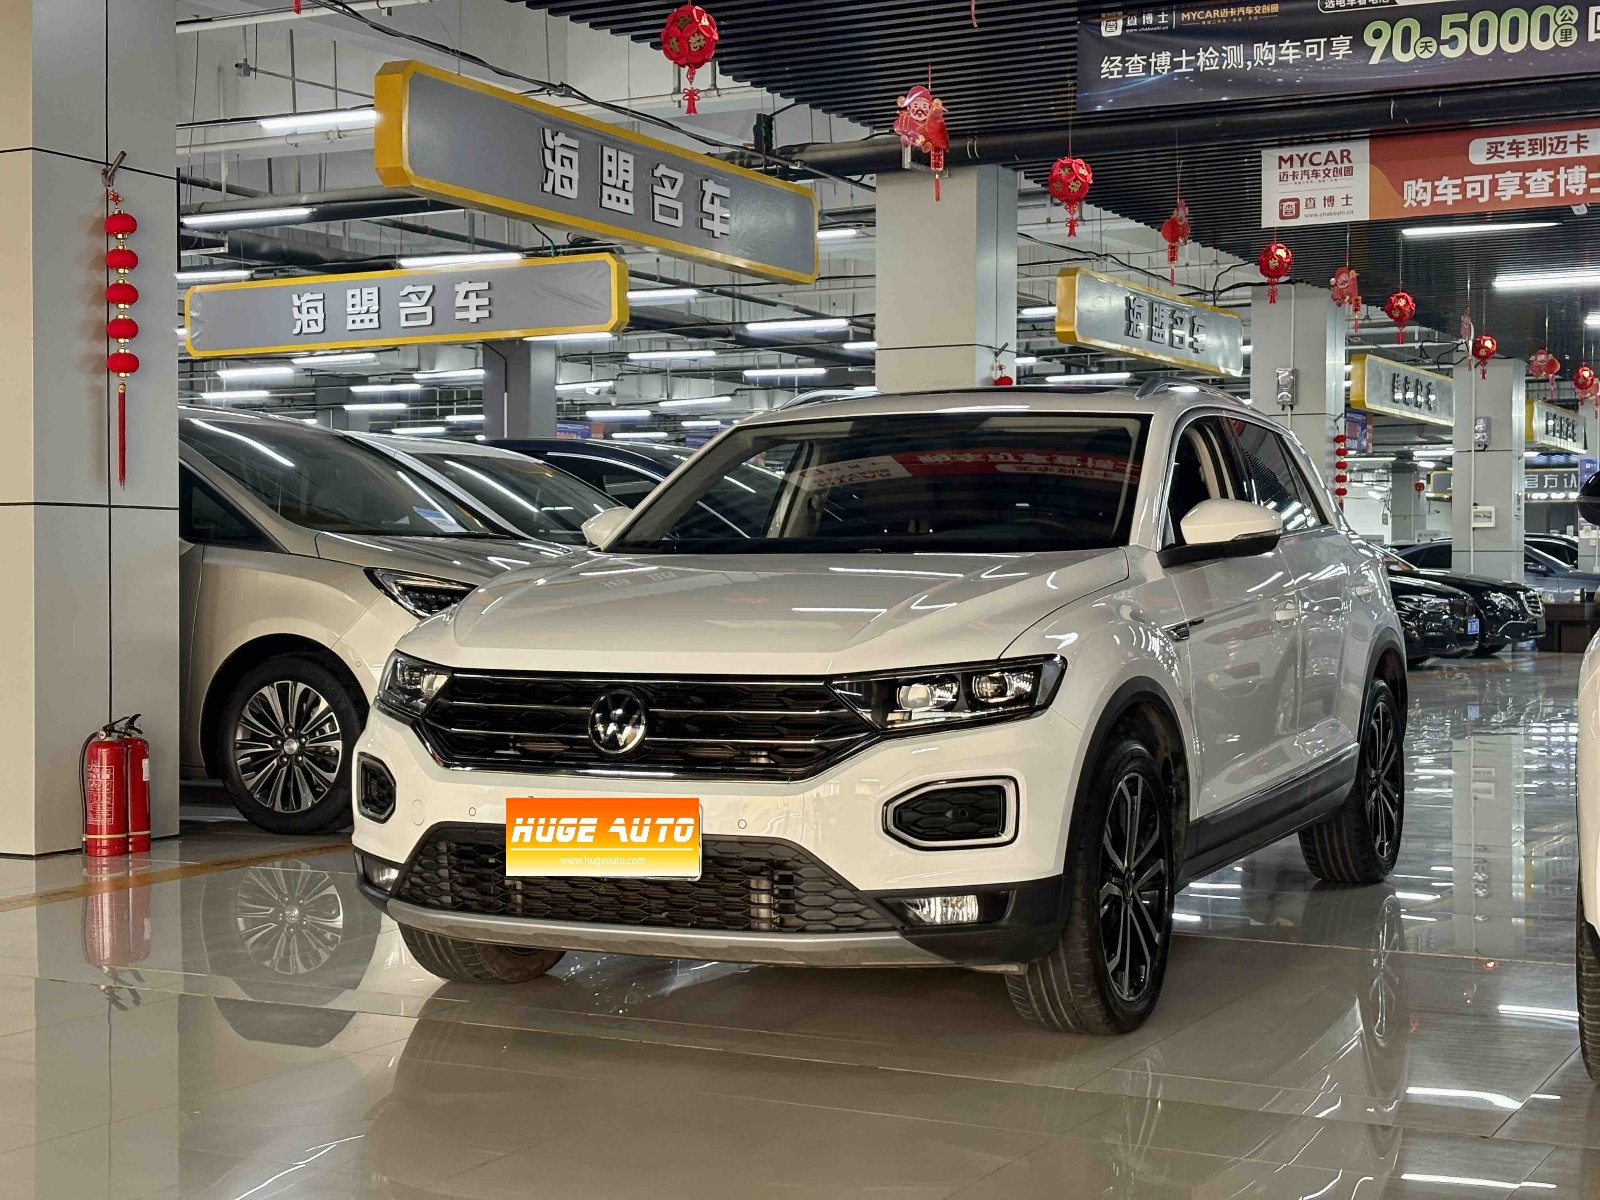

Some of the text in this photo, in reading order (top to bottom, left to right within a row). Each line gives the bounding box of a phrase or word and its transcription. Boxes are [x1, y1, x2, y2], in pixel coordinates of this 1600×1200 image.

[1278, 149, 1352, 169] MYCAR
[1485, 133, 1590, 161] 买车到迈卡
[540, 128, 730, 238] 海盟名车
[1279, 166, 1353, 182] 迈卡汽车文创园
[1304, 194, 1353, 209] 查博士
[292, 281, 491, 335] 海盟名车
